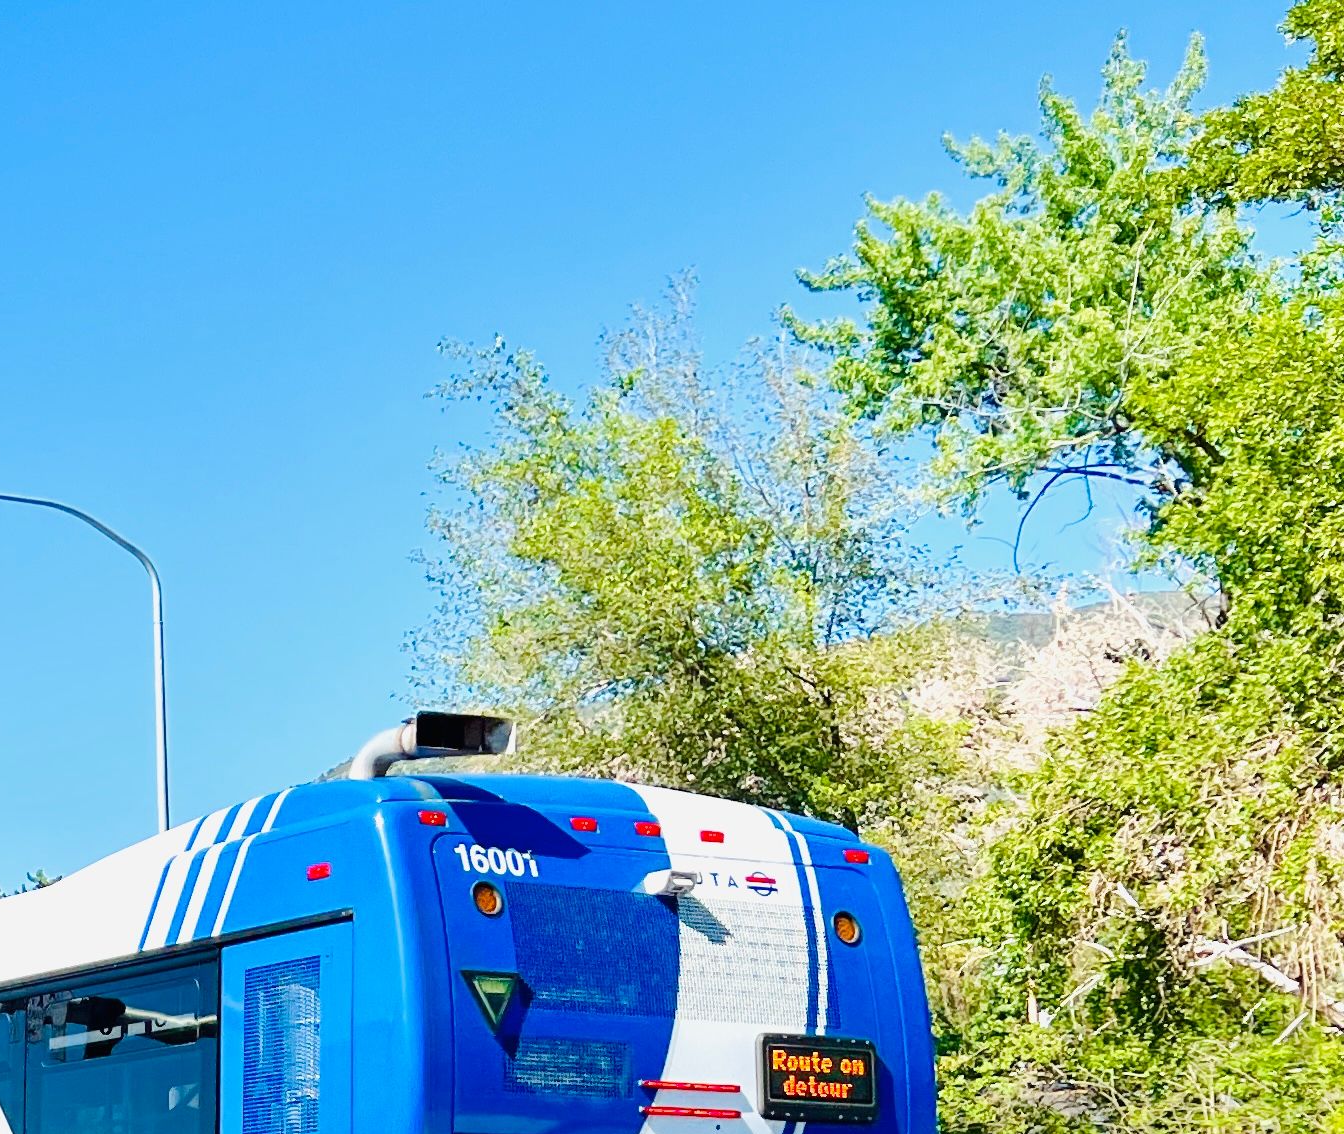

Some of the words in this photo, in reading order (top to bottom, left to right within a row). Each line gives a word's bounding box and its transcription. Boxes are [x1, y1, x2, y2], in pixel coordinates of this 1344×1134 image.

[453, 843, 539, 878] 16001
[772, 1049, 832, 1073] Route
[840, 1058, 865, 1075] on
[783, 1075, 853, 1098] detour
